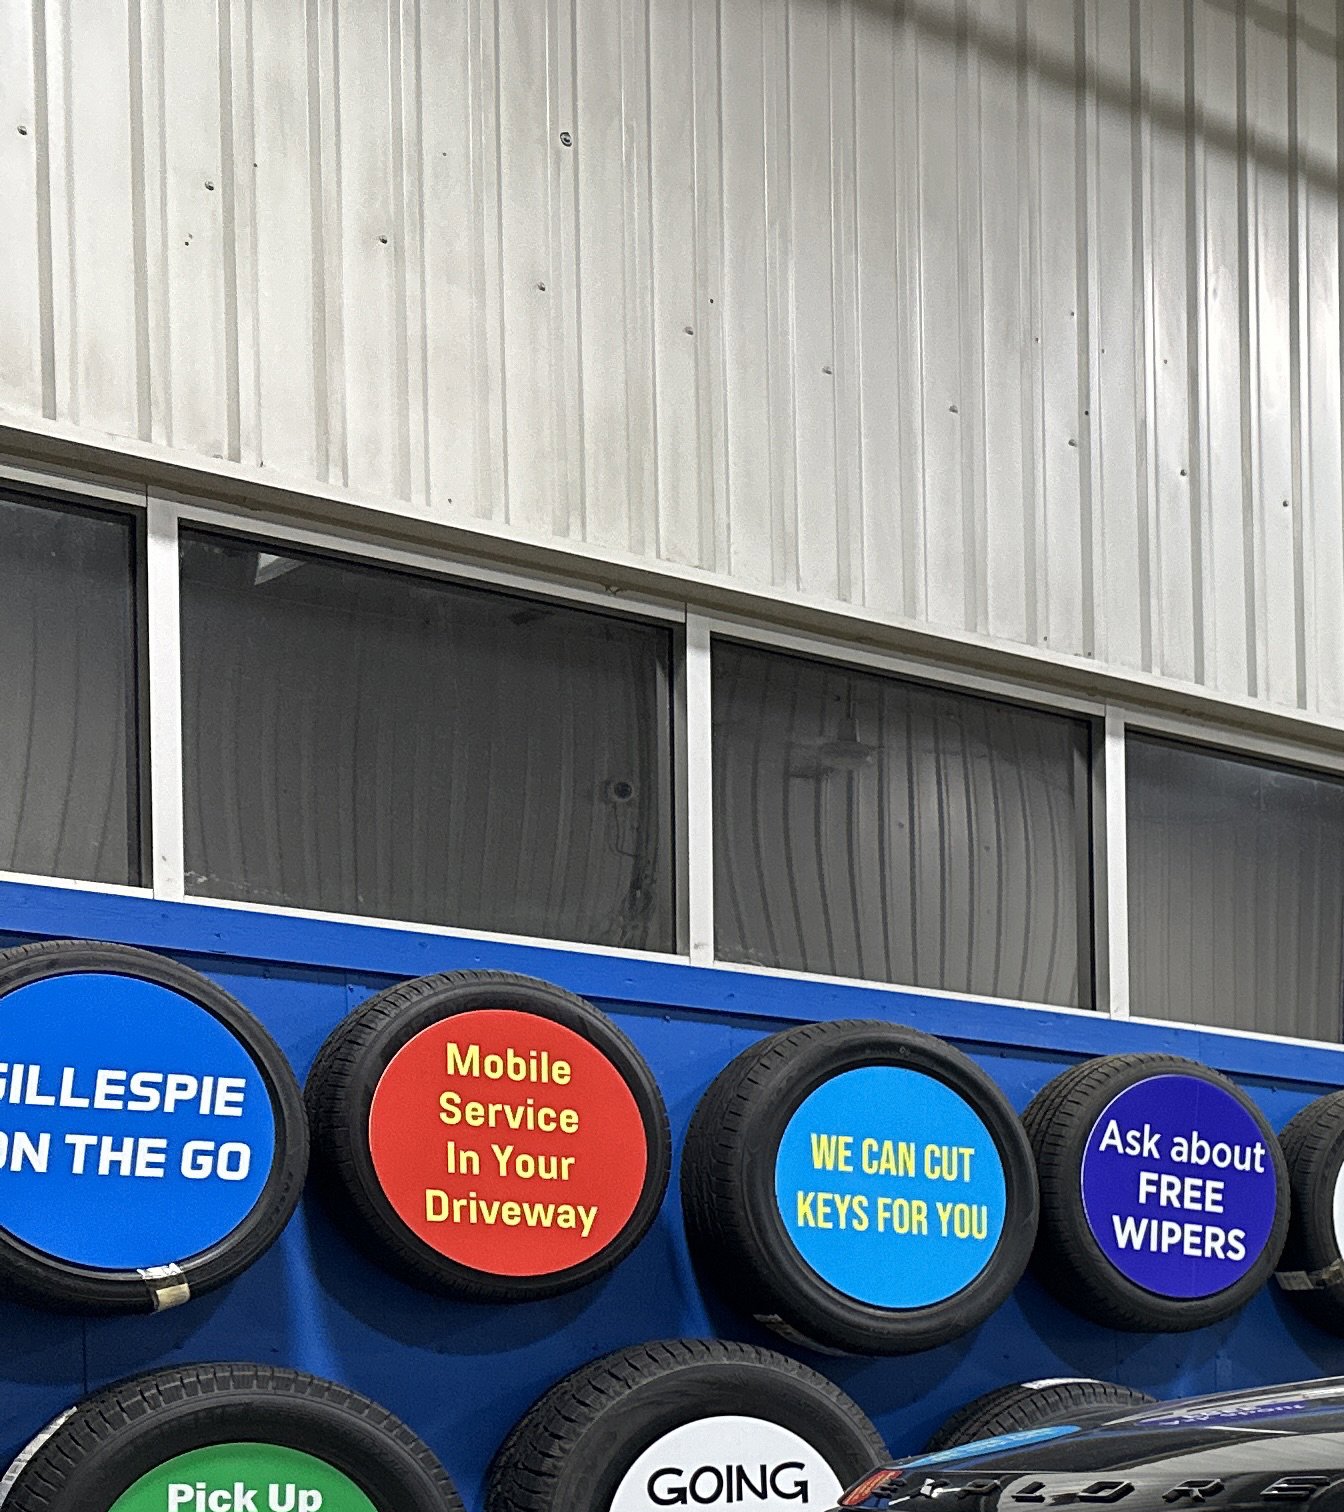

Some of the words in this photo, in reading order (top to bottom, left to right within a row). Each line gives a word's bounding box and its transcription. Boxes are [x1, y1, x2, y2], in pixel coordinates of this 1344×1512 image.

[446, 1042, 571, 1085] Mobile
[0, 1062, 247, 1117] ILLESPIE
[439, 1091, 579, 1134] Service
[0, 1130, 50, 1173] N
[64, 1133, 167, 1178] THE
[180, 1140, 250, 1181] GO
[447, 1141, 480, 1175] In
[491, 1143, 576, 1180] Your
[810, 1133, 854, 1172] WE
[862, 1137, 916, 1178] CAN
[924, 1143, 975, 1183] CUT
[1099, 1119, 1161, 1159] Ask
[1170, 1130, 1266, 1174] about
[425, 1188, 598, 1238] Driveway
[797, 1190, 869, 1231] KEYS
[877, 1197, 928, 1236] FOR
[936, 1201, 988, 1240] YOU
[1138, 1171, 1225, 1214] FREE
[1111, 1214, 1247, 1262] WIPERS
[167, 1482, 258, 1512] Pick
[647, 1461, 809, 1506] GOING
